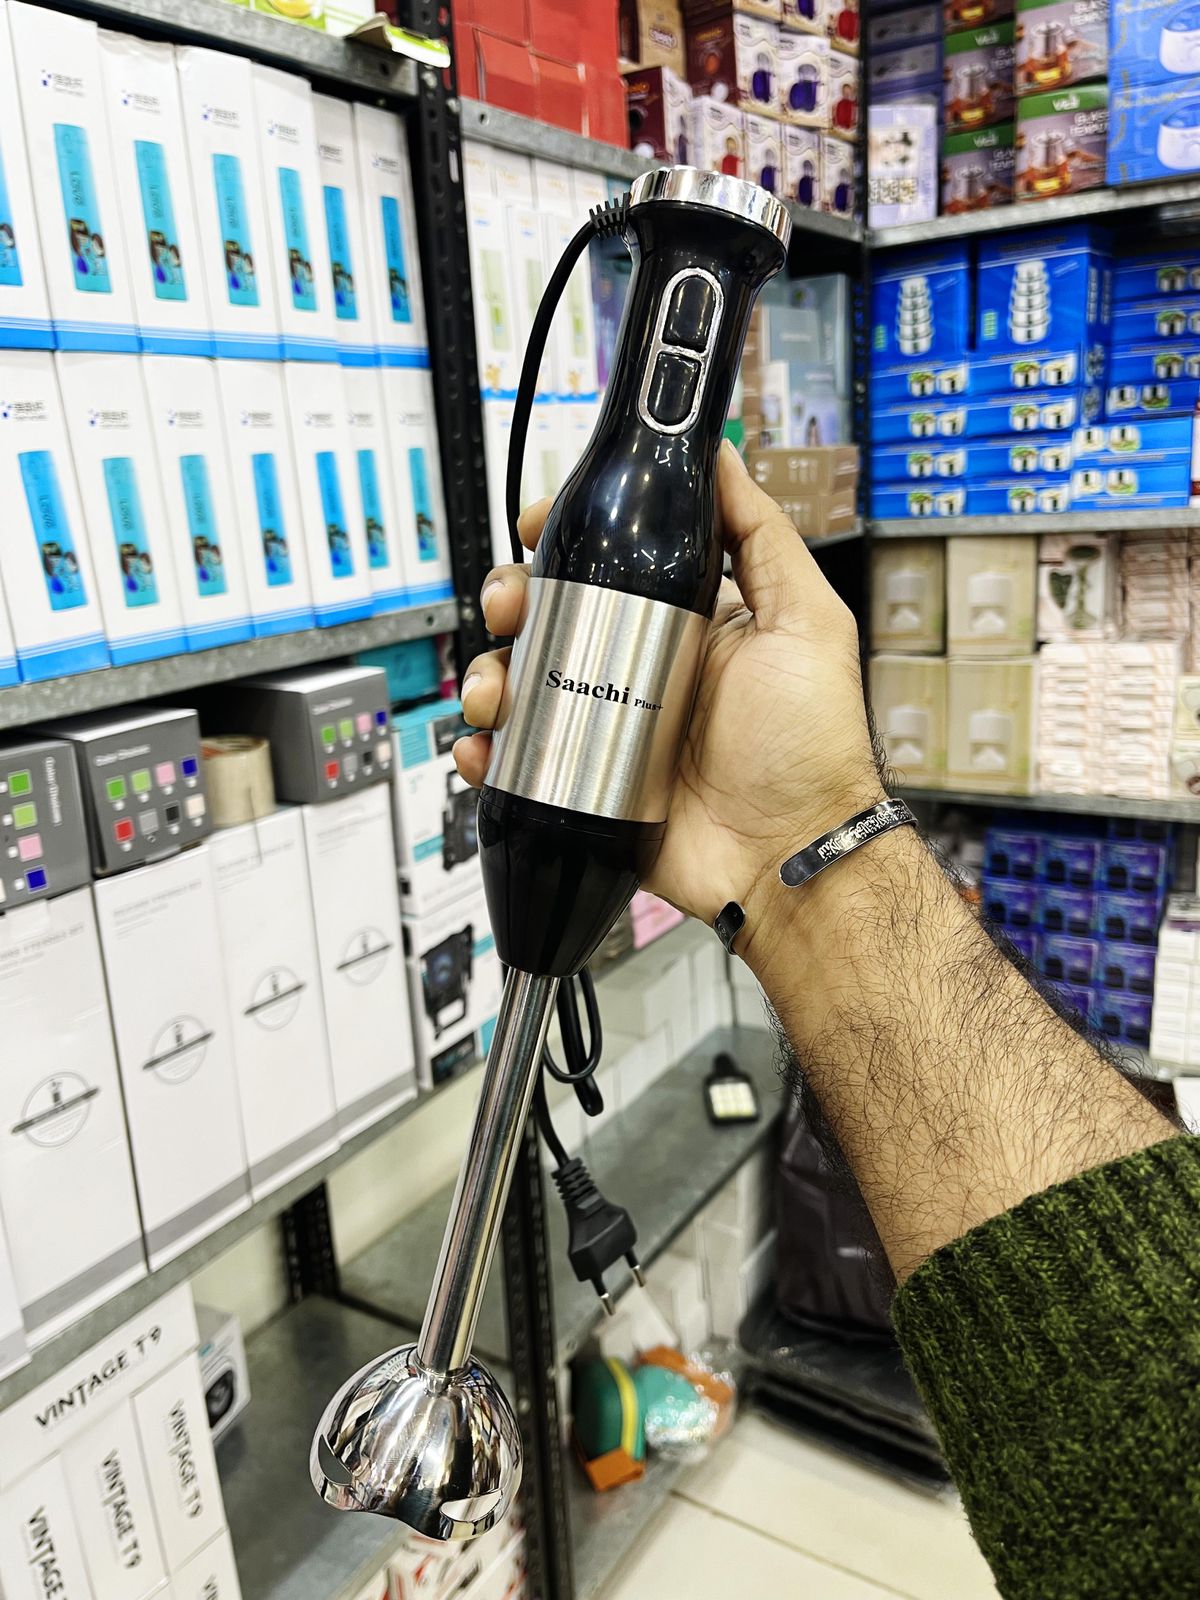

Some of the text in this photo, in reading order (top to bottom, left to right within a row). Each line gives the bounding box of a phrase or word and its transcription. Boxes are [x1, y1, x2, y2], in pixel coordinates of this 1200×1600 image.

[546, 670, 664, 711] Saachi Plus+
[36, 1350, 129, 1427] VINTAGE
[168, 1399, 198, 1489] VINTAGE
[102, 1449, 135, 1539] VINTAGE
